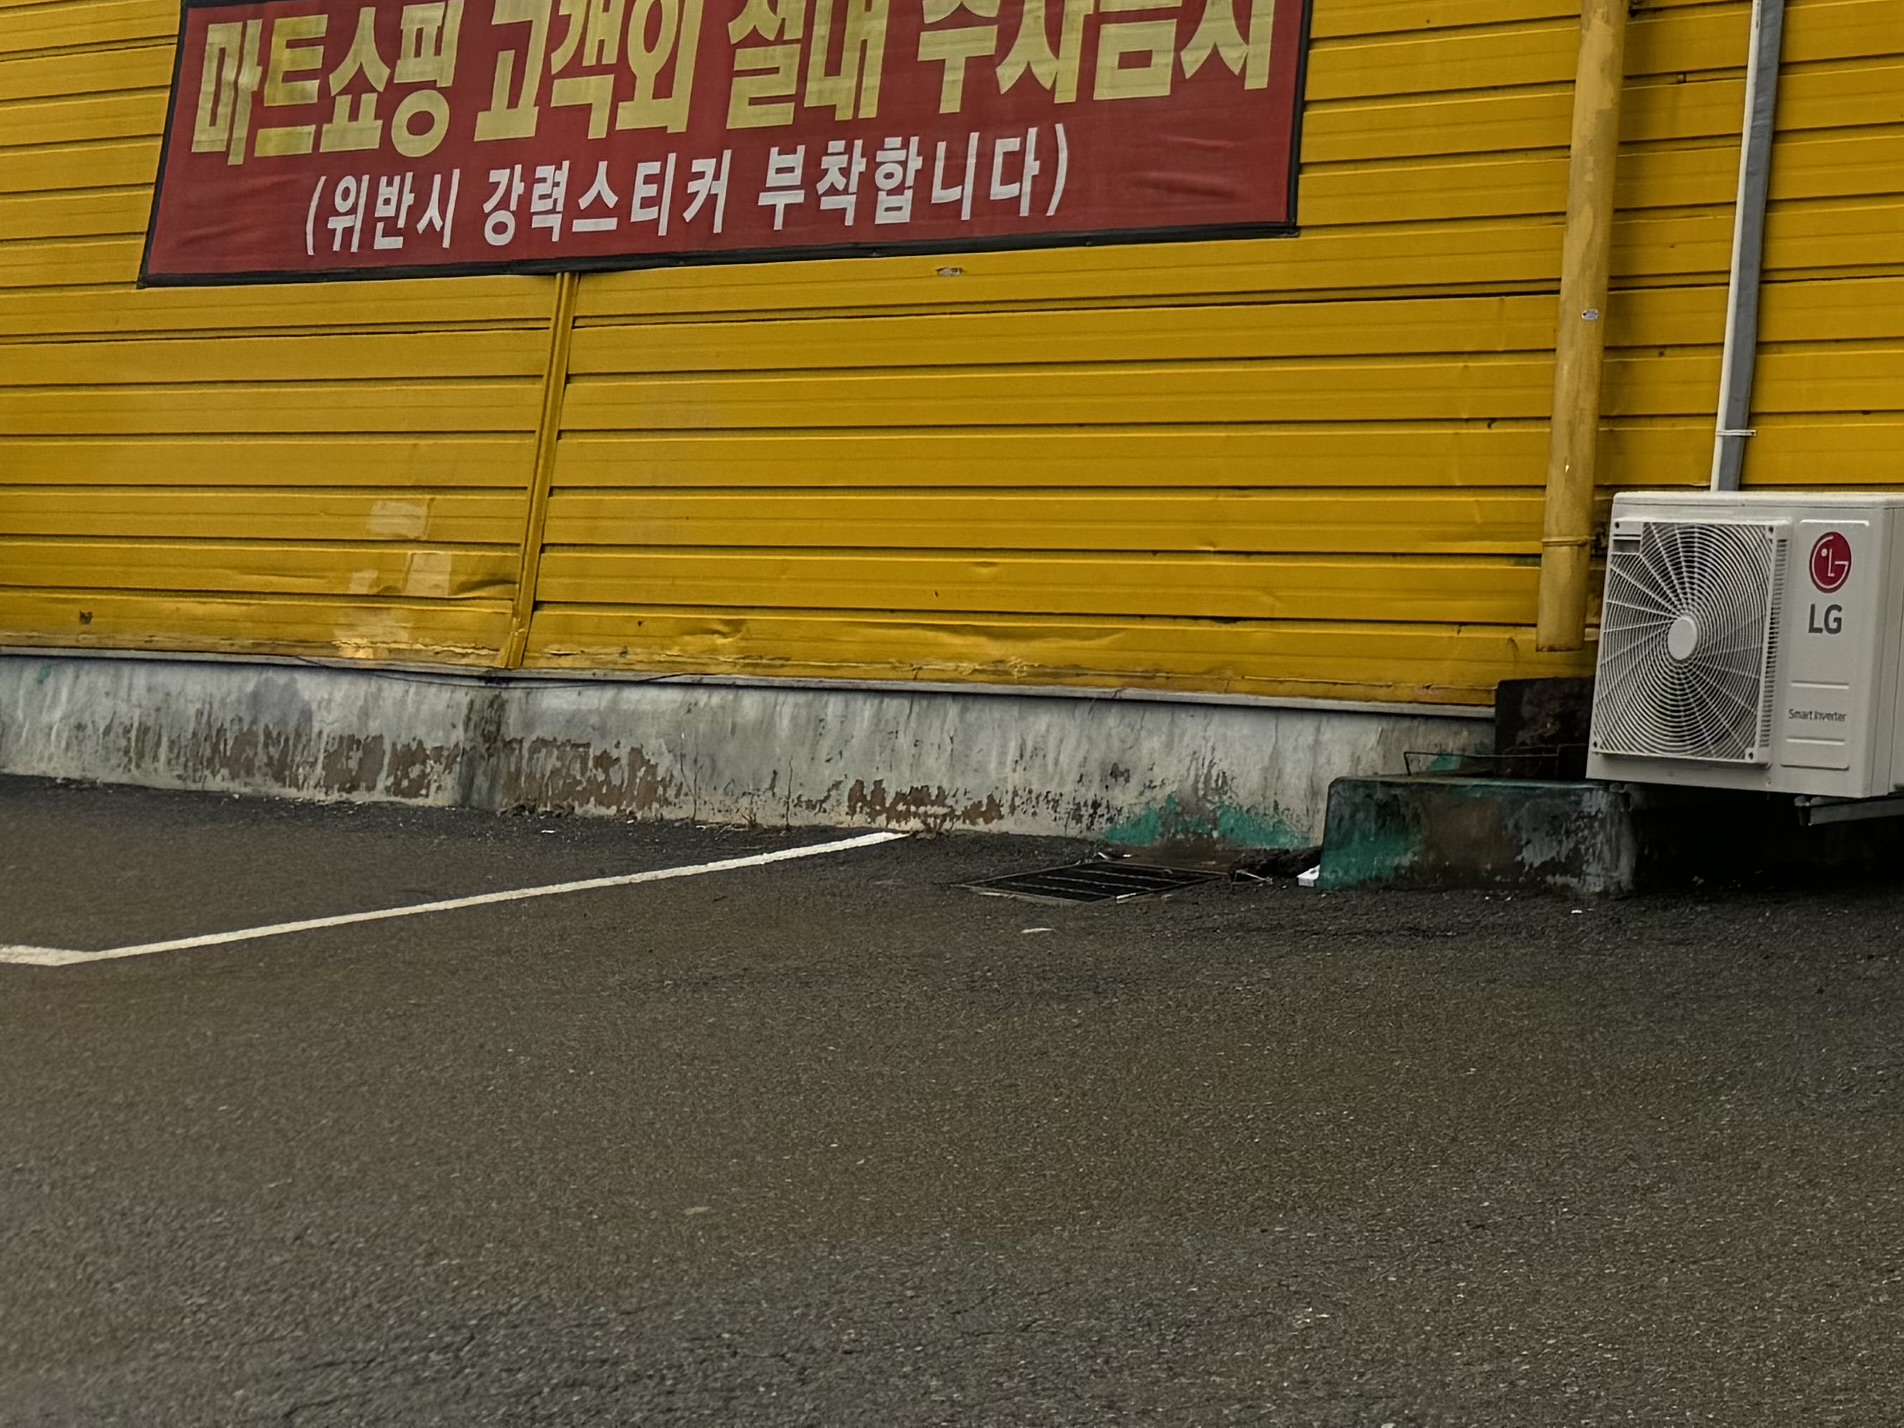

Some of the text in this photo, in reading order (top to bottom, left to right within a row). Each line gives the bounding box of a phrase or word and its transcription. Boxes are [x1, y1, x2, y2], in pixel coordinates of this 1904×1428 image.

[302, 122, 1073, 256] (위반시 강력스티커 부착합니다)
[1807, 602, 1843, 635] LG
[1788, 708, 1814, 721] Smart
